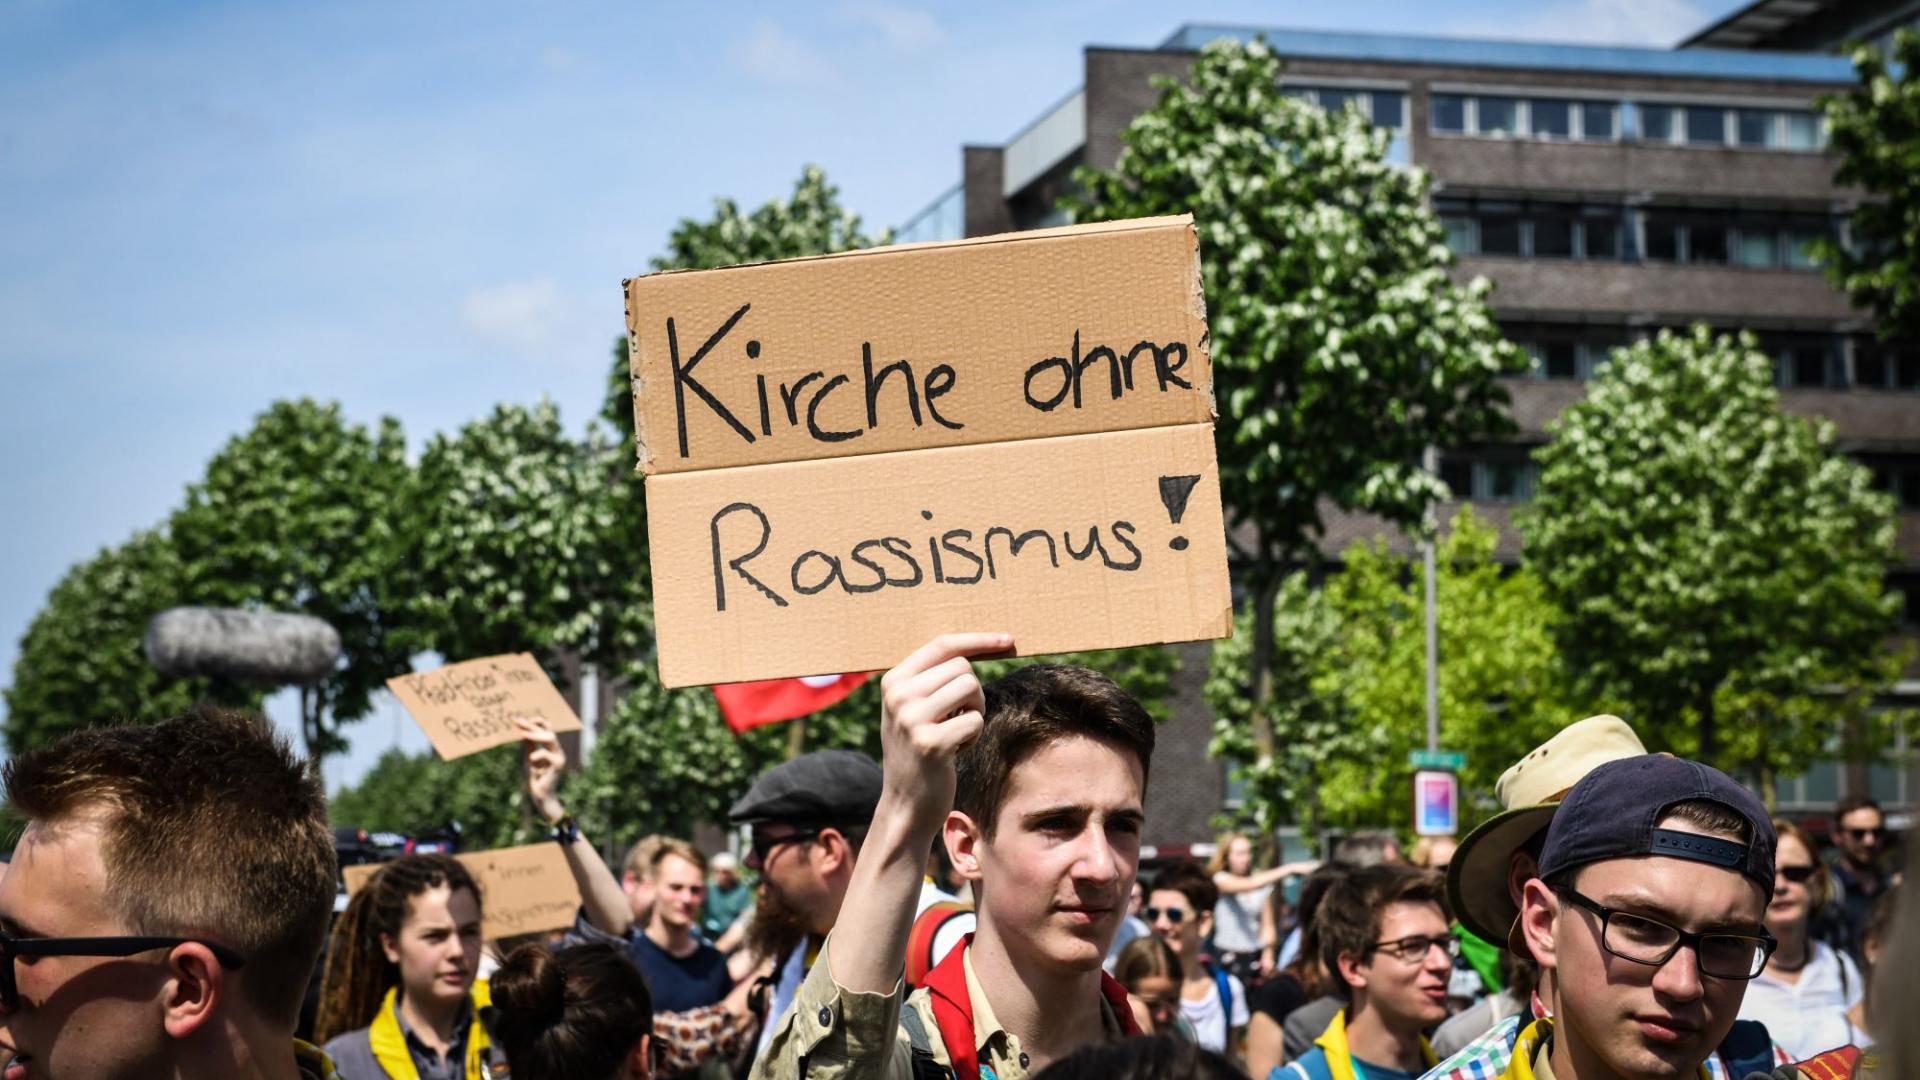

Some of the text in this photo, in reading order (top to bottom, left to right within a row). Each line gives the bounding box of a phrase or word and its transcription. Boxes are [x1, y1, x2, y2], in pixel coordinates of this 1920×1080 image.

[667, 304, 1192, 457] Kirche ohne
[711, 475, 1201, 610] Rassismus!
